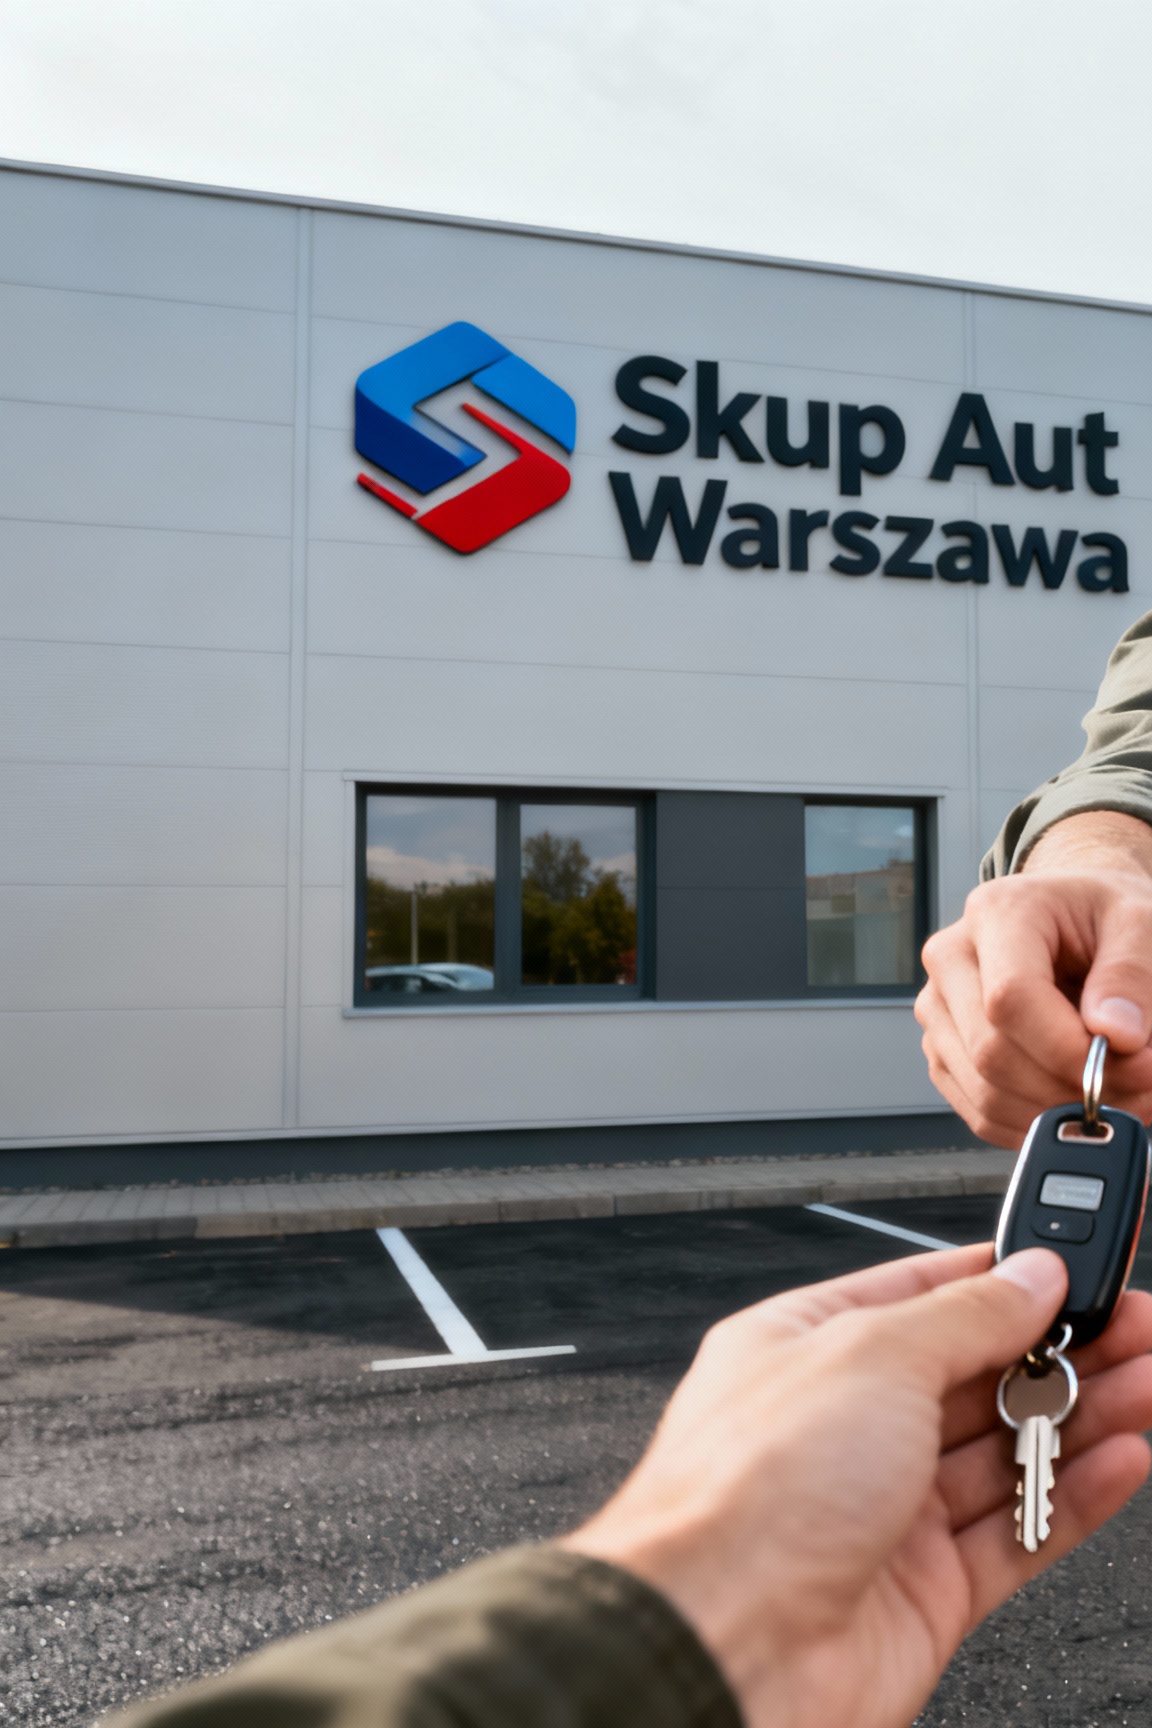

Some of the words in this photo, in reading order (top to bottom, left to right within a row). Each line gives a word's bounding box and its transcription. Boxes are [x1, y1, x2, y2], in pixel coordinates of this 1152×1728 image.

[611, 355, 906, 497] Skup
[928, 392, 1120, 497] Aut
[608, 471, 1130, 594] Warszawa
